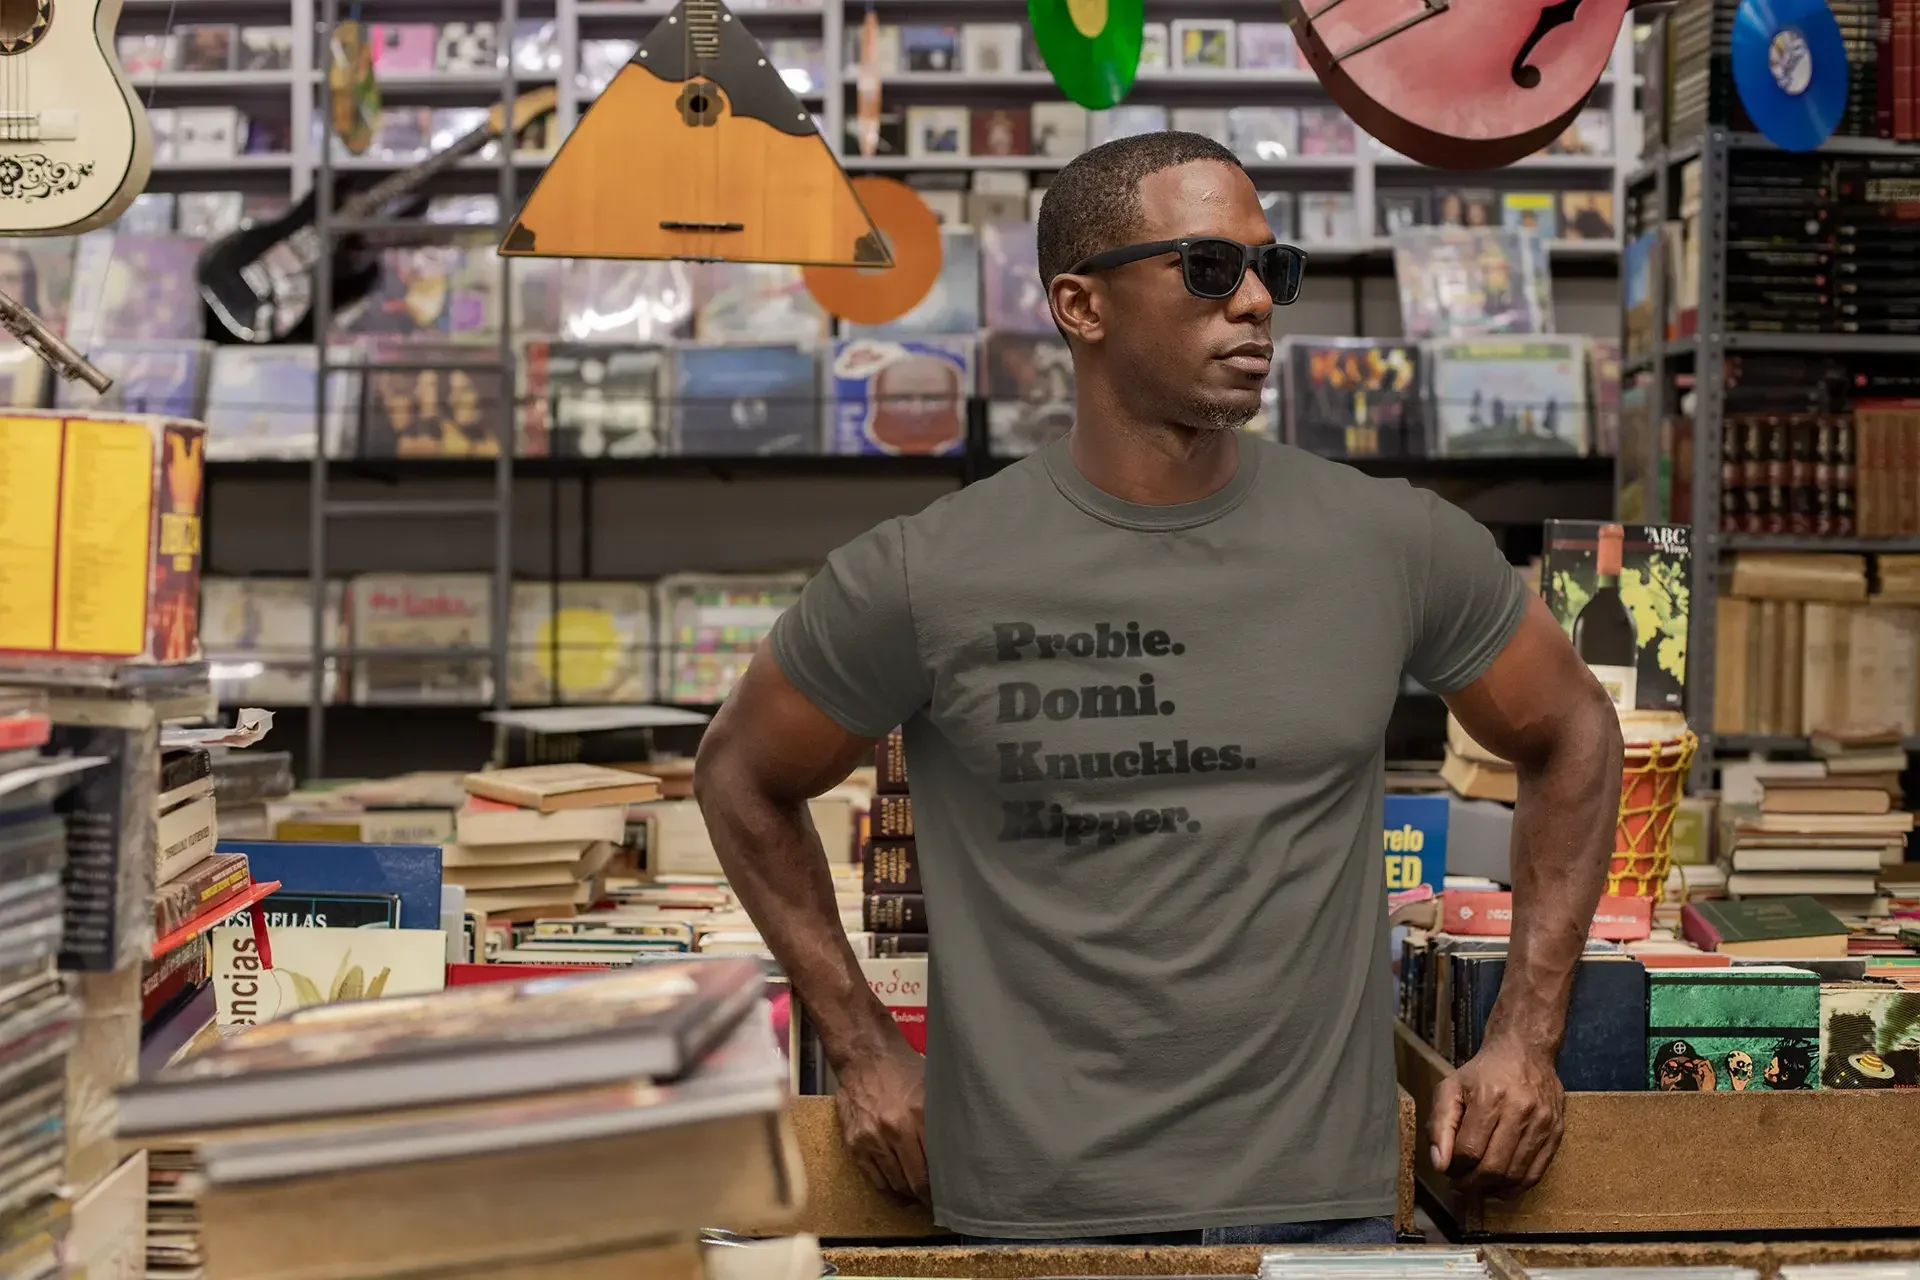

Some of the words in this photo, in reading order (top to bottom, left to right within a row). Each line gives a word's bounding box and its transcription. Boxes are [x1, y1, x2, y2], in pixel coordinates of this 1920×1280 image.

[993, 621, 1186, 661] Probie.
[996, 672, 1175, 724] Domi.
[996, 739, 1257, 783] Knuckles.
[997, 800, 1202, 847] Kipper.
